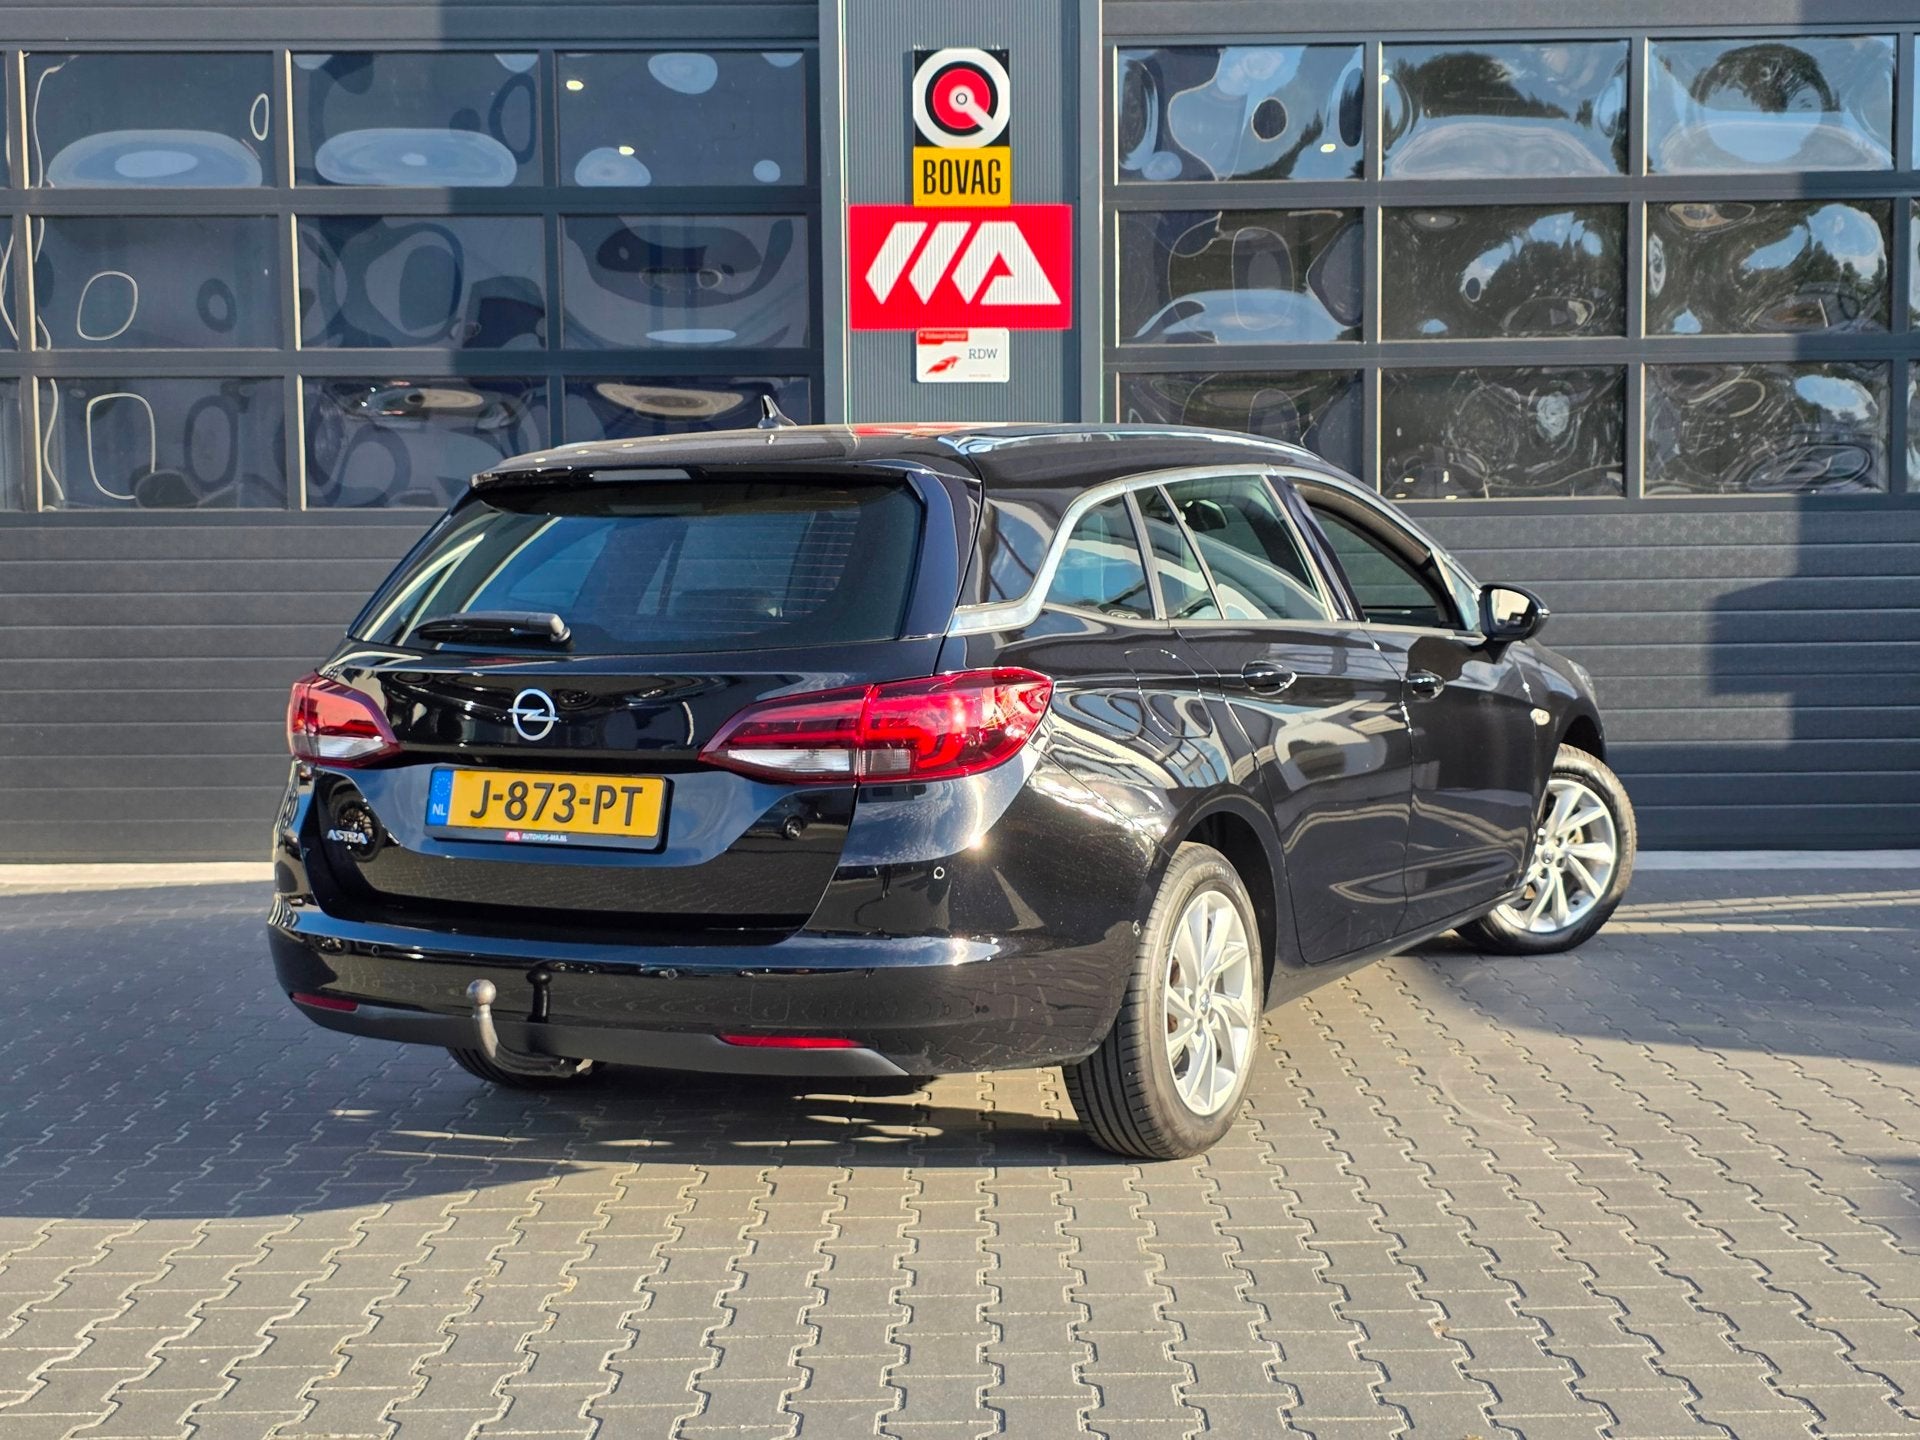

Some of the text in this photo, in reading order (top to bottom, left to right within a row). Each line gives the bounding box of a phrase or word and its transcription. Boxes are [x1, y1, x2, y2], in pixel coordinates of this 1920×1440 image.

[923, 159, 1001, 195] BOVAG
[968, 348, 998, 359] RDW
[432, 803, 447, 816] NL
[470, 780, 643, 826] J-873-PT
[327, 829, 368, 845] ASTRA
